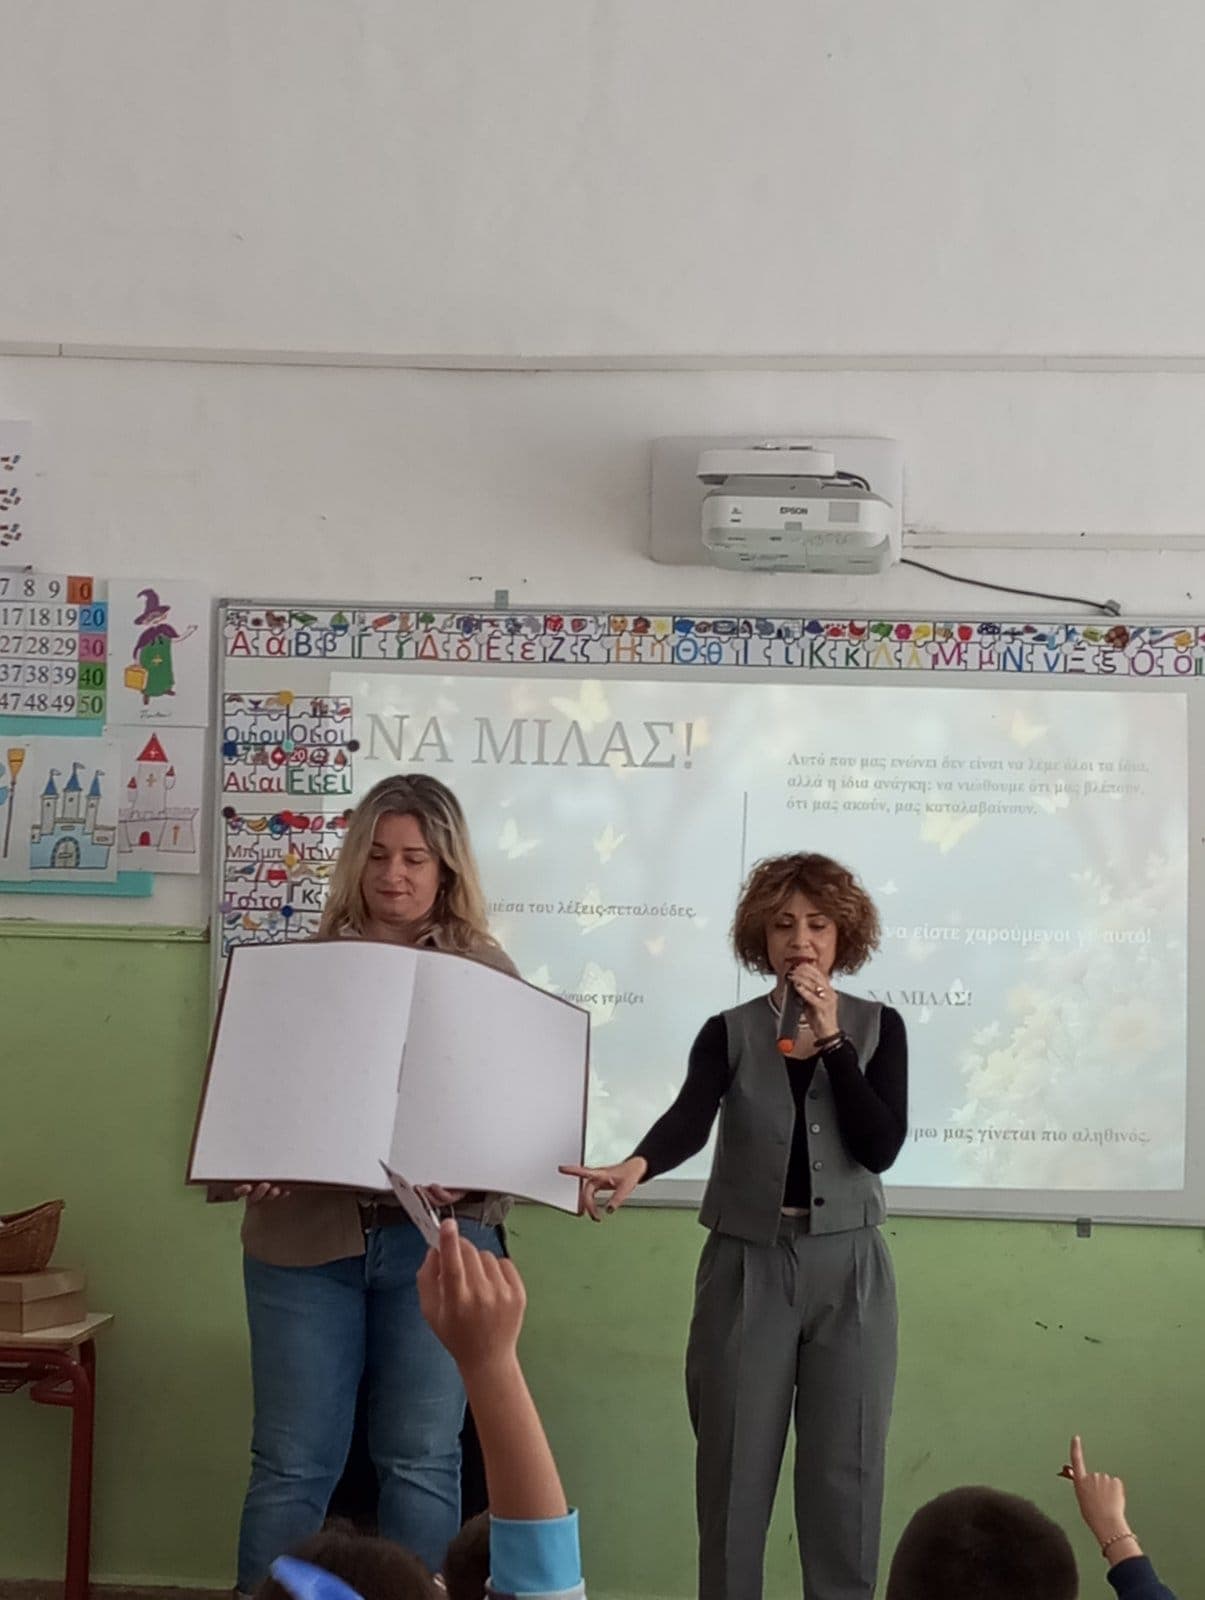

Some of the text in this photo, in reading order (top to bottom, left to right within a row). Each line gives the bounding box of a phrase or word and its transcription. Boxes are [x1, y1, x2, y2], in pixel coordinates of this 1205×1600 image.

[779, 506, 807, 515] EPSON
[24, 579, 35, 597] 8
[48, 580, 60, 598] 9
[2, 608, 105, 627] 17 18 19 20
[0, 635, 104, 657] 27 28 29 30
[26, 665, 49, 684] 38
[53, 666, 76, 685] 39
[80, 668, 104, 686] 40
[24, 693, 47, 712] 48
[51, 694, 75, 713] 49
[80, 696, 103, 714] 50
[364, 713, 694, 769] ΝΑ ΜΙΛΑΣ!
[787, 752, 825, 767] Αυτό
[829, 756, 856, 767] που
[860, 756, 886, 770] μας
[890, 754, 937, 768] ενώνει
[941, 755, 965, 768] δεν
[969, 755, 1003, 770] είναι
[1007, 760, 1024, 771] να
[1098, 761, 1113, 772] τα
[787, 774, 823, 788] αλλά
[827, 778, 836, 792] η
[841, 775, 869, 789] ίδια
[873, 776, 932, 794] ανάγκη:
[937, 781, 953, 791] να
[958, 779, 1025, 796] νιώθουμε
[1055, 783, 1080, 795] μας
[786, 796, 1038, 817] ότι μας ακούν, μας καταλαβαίνουν.
[529, 902, 554, 913] του
[913, 922, 960, 940] είστε
[964, 925, 1070, 946] χαρούμενοι
[601, 990, 644, 1005] γεμίζει
[899, 990, 973, 1006] ΜΙΛΑΣ!
[943, 1128, 974, 1144] μας
[977, 1125, 1037, 1144] γίνεται
[1041, 1128, 1067, 1142] πιο
[1072, 1127, 1152, 1146] αληθινός.
